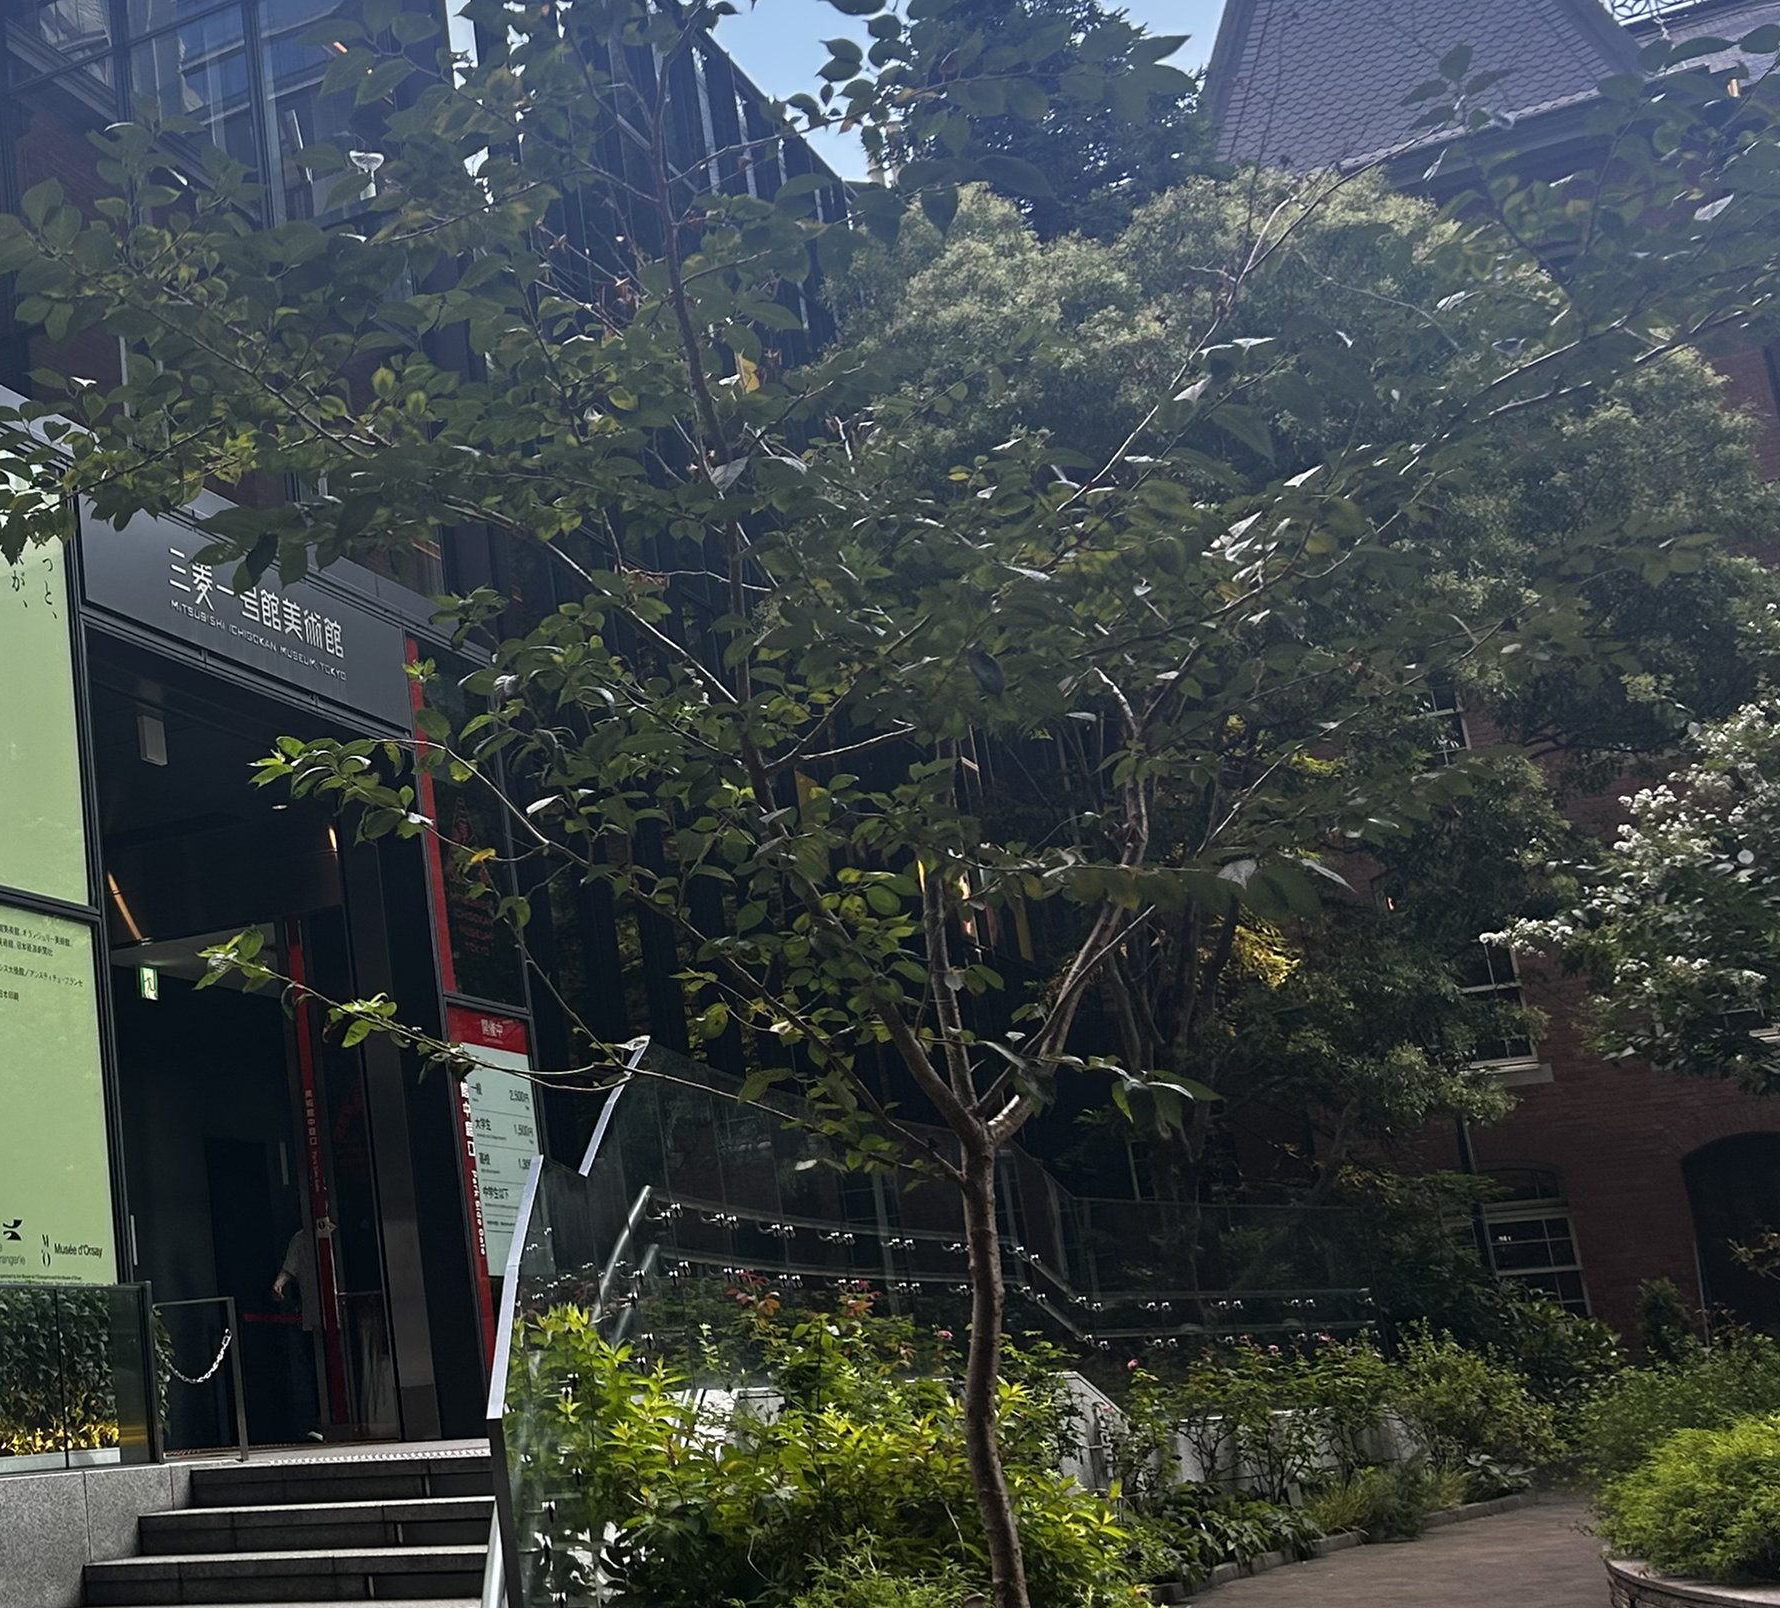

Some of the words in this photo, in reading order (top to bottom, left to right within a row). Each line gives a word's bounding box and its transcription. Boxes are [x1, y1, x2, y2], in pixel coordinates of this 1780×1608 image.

[169, 547, 345, 659] 三菱一号館美術館
[170, 599, 226, 631] MITSUBISHI
[228, 623, 278, 653] ICHIGOKAN
[319, 661, 348, 682] TOKYO
[54, 1243, 77, 1256] Musée
[78, 1244, 103, 1259] d'Orsay
